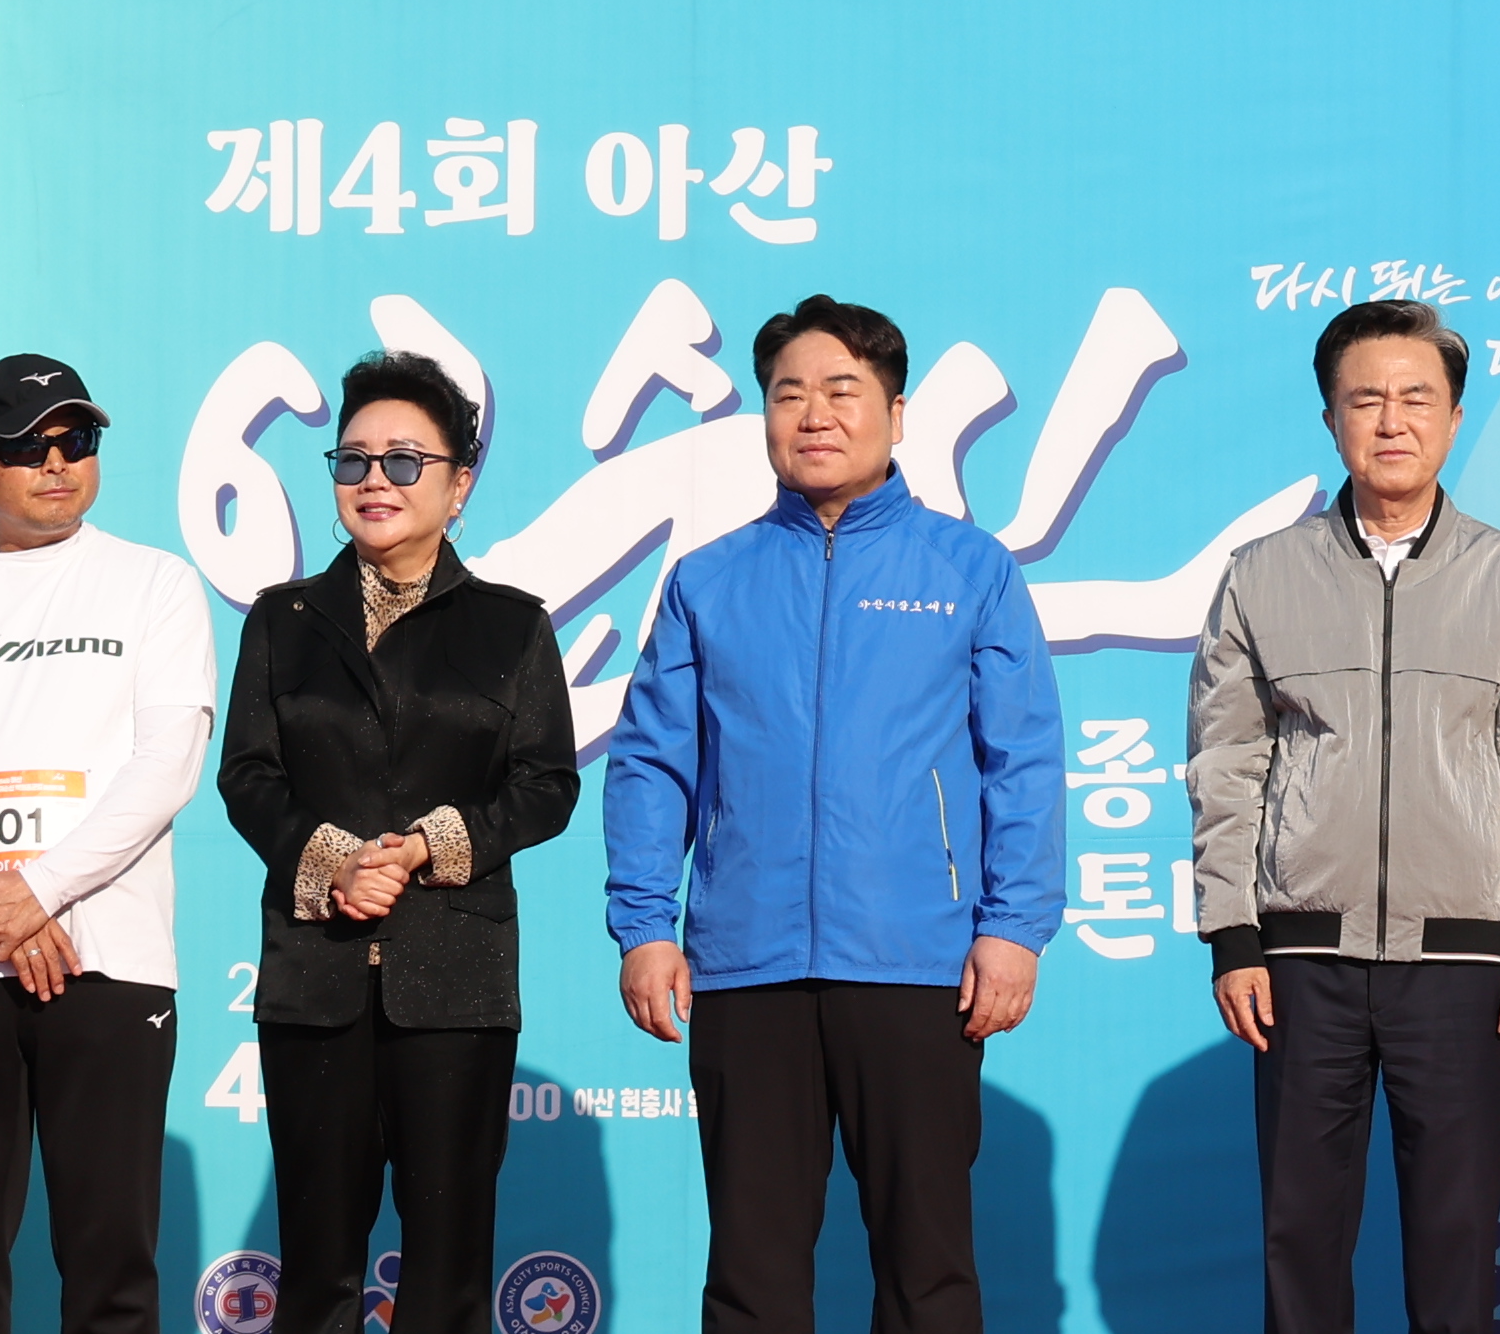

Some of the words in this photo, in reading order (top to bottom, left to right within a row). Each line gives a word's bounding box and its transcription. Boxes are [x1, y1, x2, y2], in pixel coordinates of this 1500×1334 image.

[204, 118, 538, 236] 제4회
[585, 124, 832, 245] 아산
[1251, 263, 1355, 311] 다시
[573, 1087, 616, 1117] 아산
[619, 1087, 683, 1118] 현충사
[506, 1287, 517, 1314] ASAN
[513, 1267, 532, 1286] CITY
[534, 1262, 572, 1277] SPORTS
[571, 1274, 590, 1315] COUNCIL
